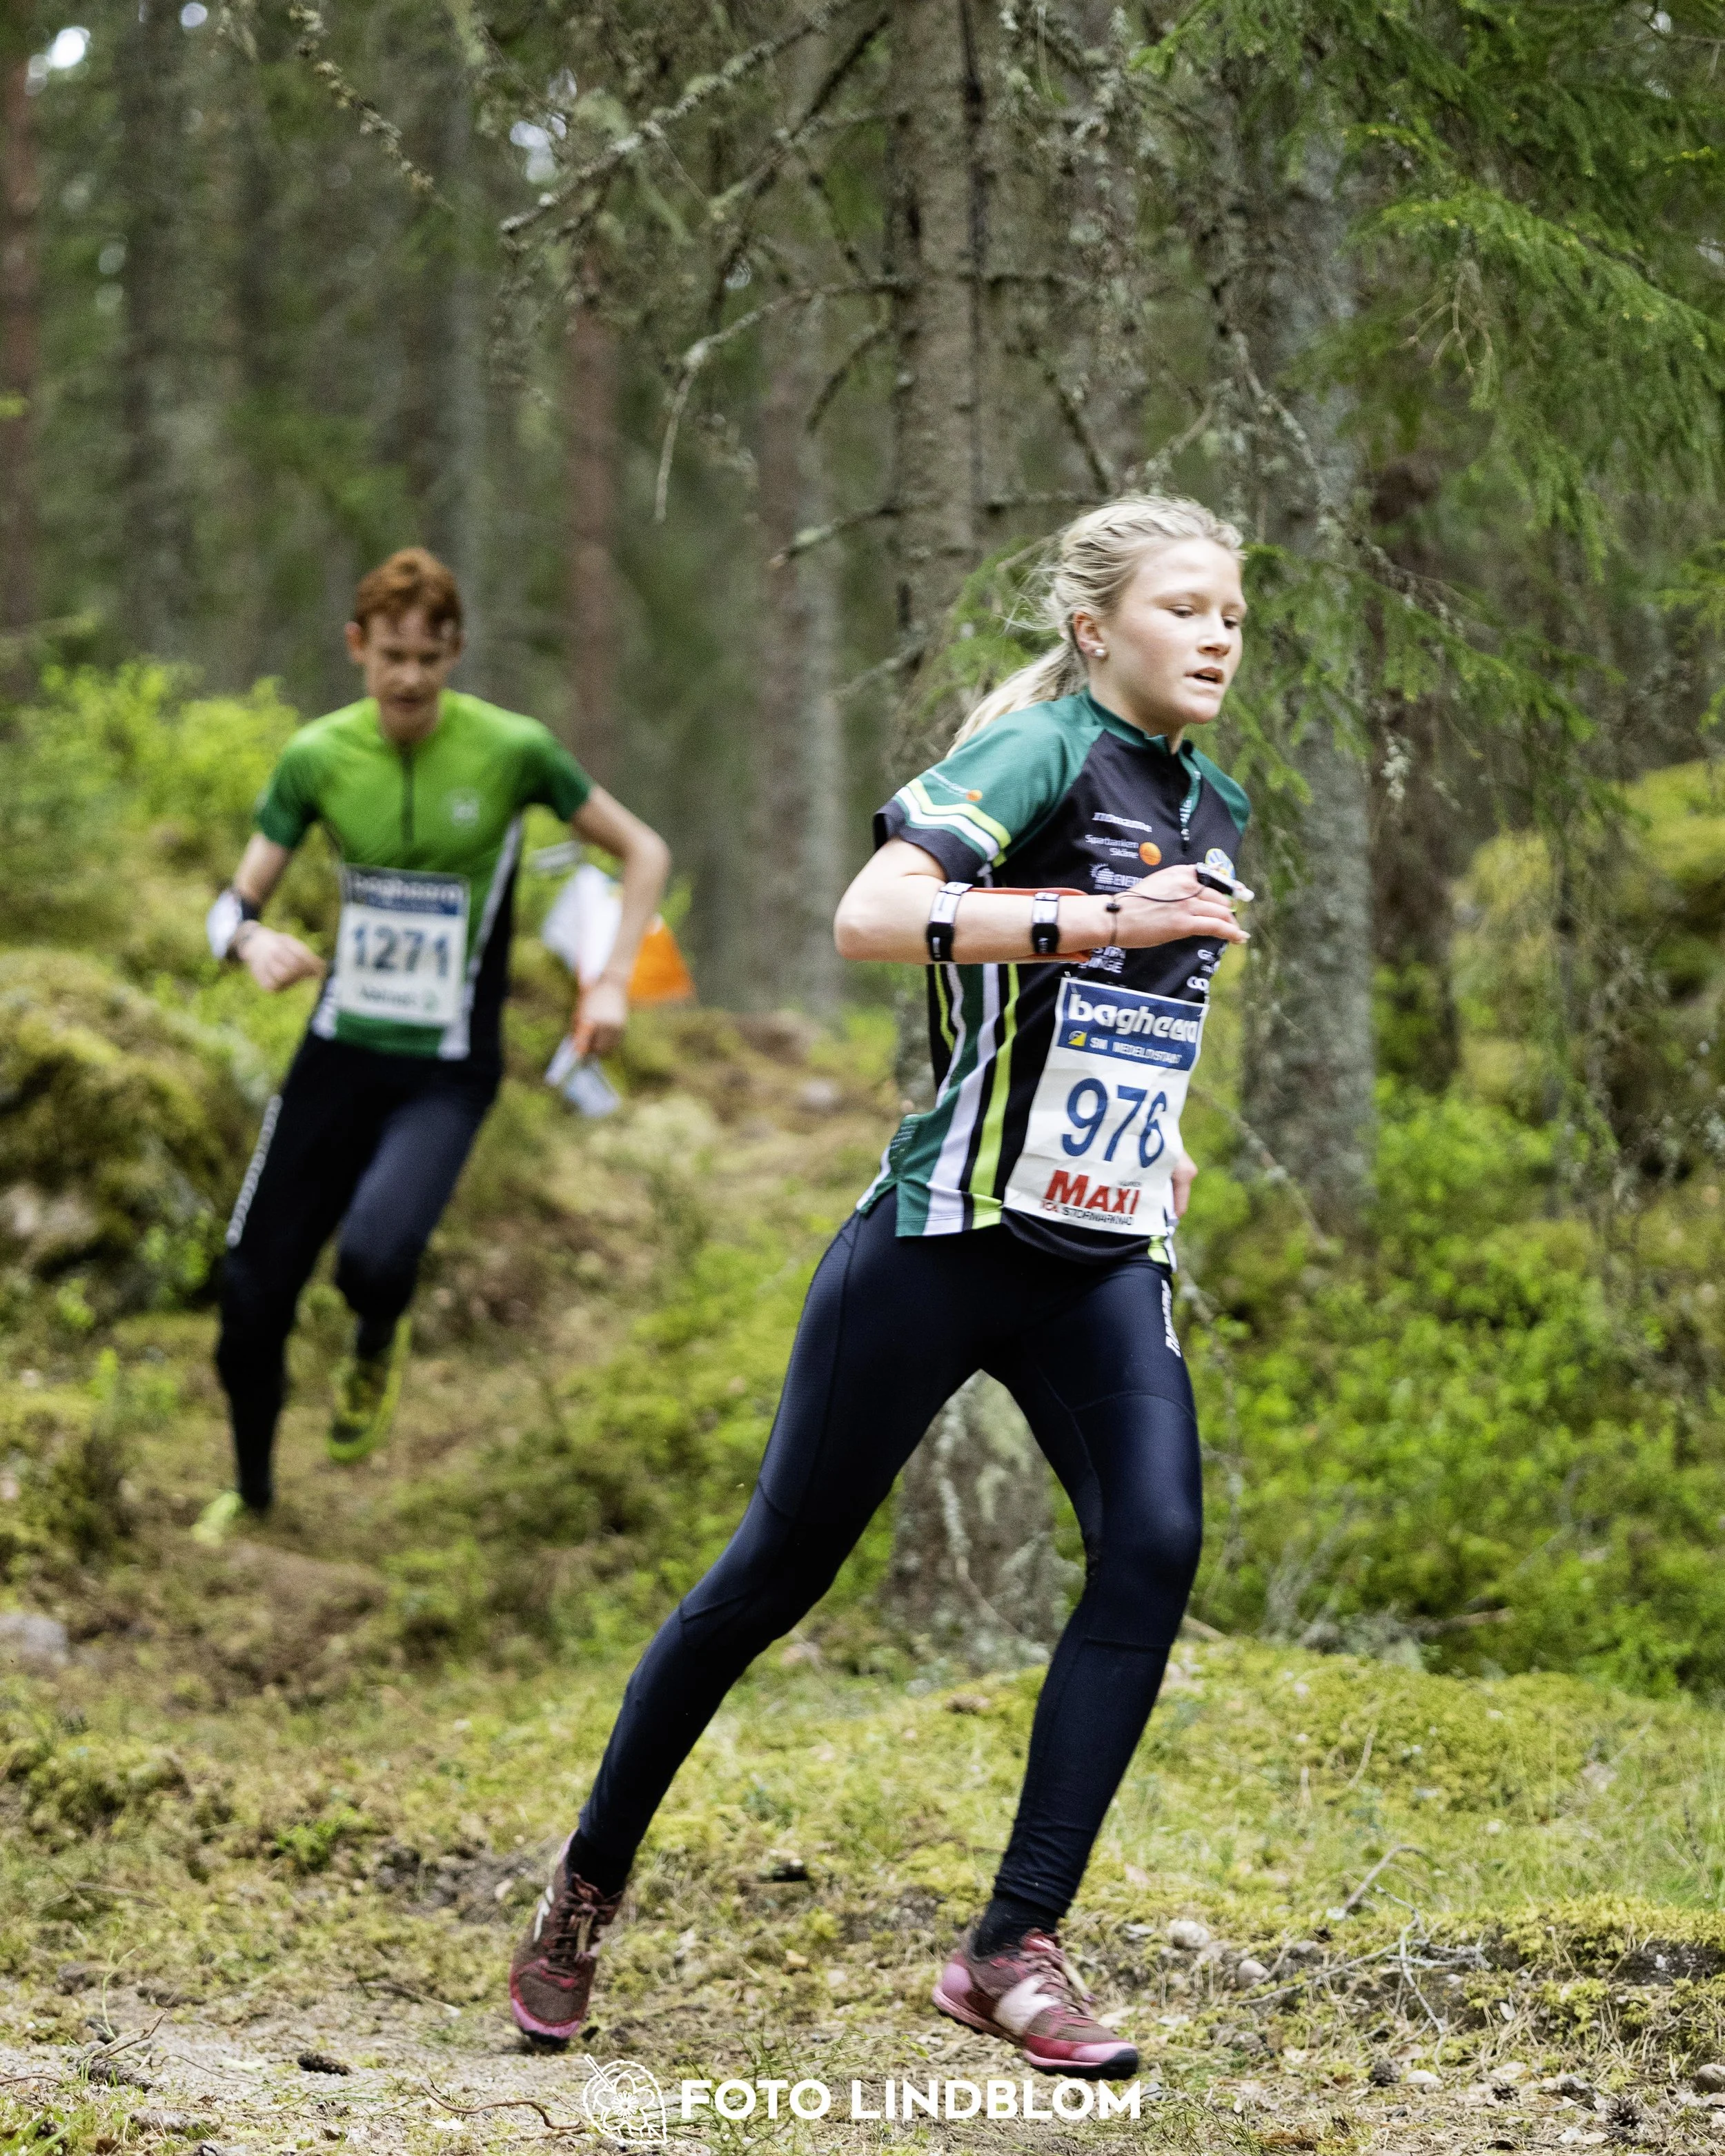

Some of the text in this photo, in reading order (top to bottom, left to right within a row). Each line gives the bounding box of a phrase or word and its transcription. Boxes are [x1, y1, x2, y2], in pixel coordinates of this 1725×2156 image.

[354, 922, 448, 979] 1271
[1062, 1078, 1167, 1168] 976
[1045, 1169, 1141, 1214] MAXI
